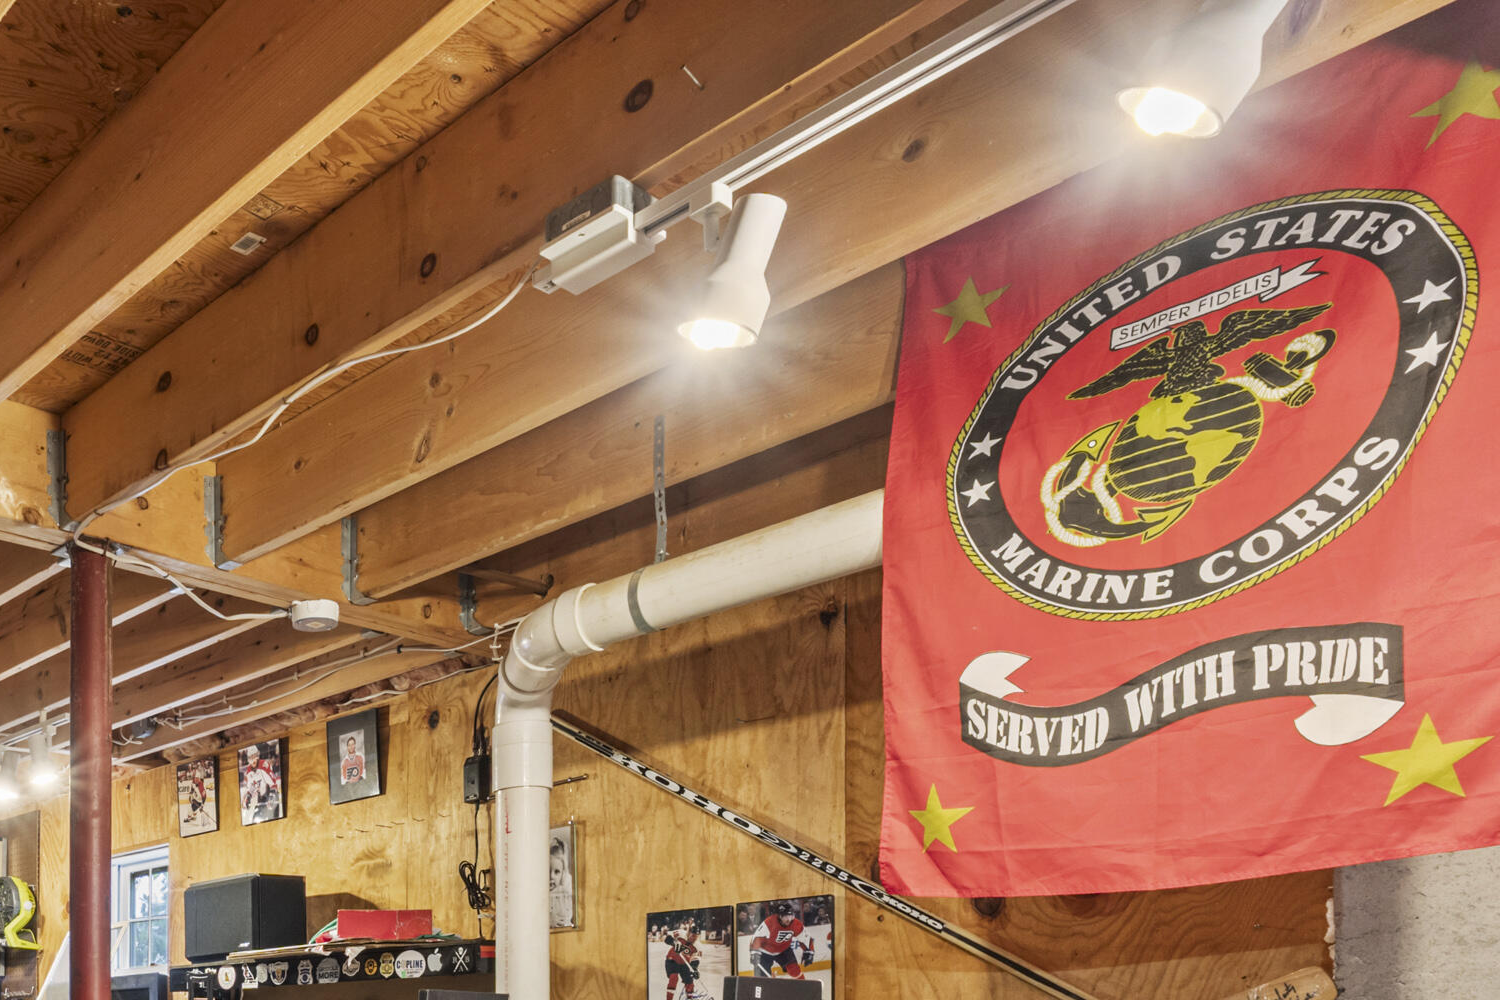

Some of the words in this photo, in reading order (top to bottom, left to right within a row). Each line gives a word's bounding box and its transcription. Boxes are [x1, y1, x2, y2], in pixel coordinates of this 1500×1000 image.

[1001, 255, 1182, 392] UNITED
[1209, 209, 1417, 260] STATES
[1118, 306, 1190, 341] SEMPER
[1198, 274, 1272, 313] FIDELIS
[991, 533, 1175, 605] MARINE
[1198, 436, 1399, 584] CORPS
[966, 698, 1109, 757] SERVED
[1123, 650, 1236, 733] WITH
[1252, 637, 1390, 691] PRIDE
[799, 851, 849, 882] 2295
[881, 893, 944, 931] KOHO
[318, 971, 339, 980] MORE
